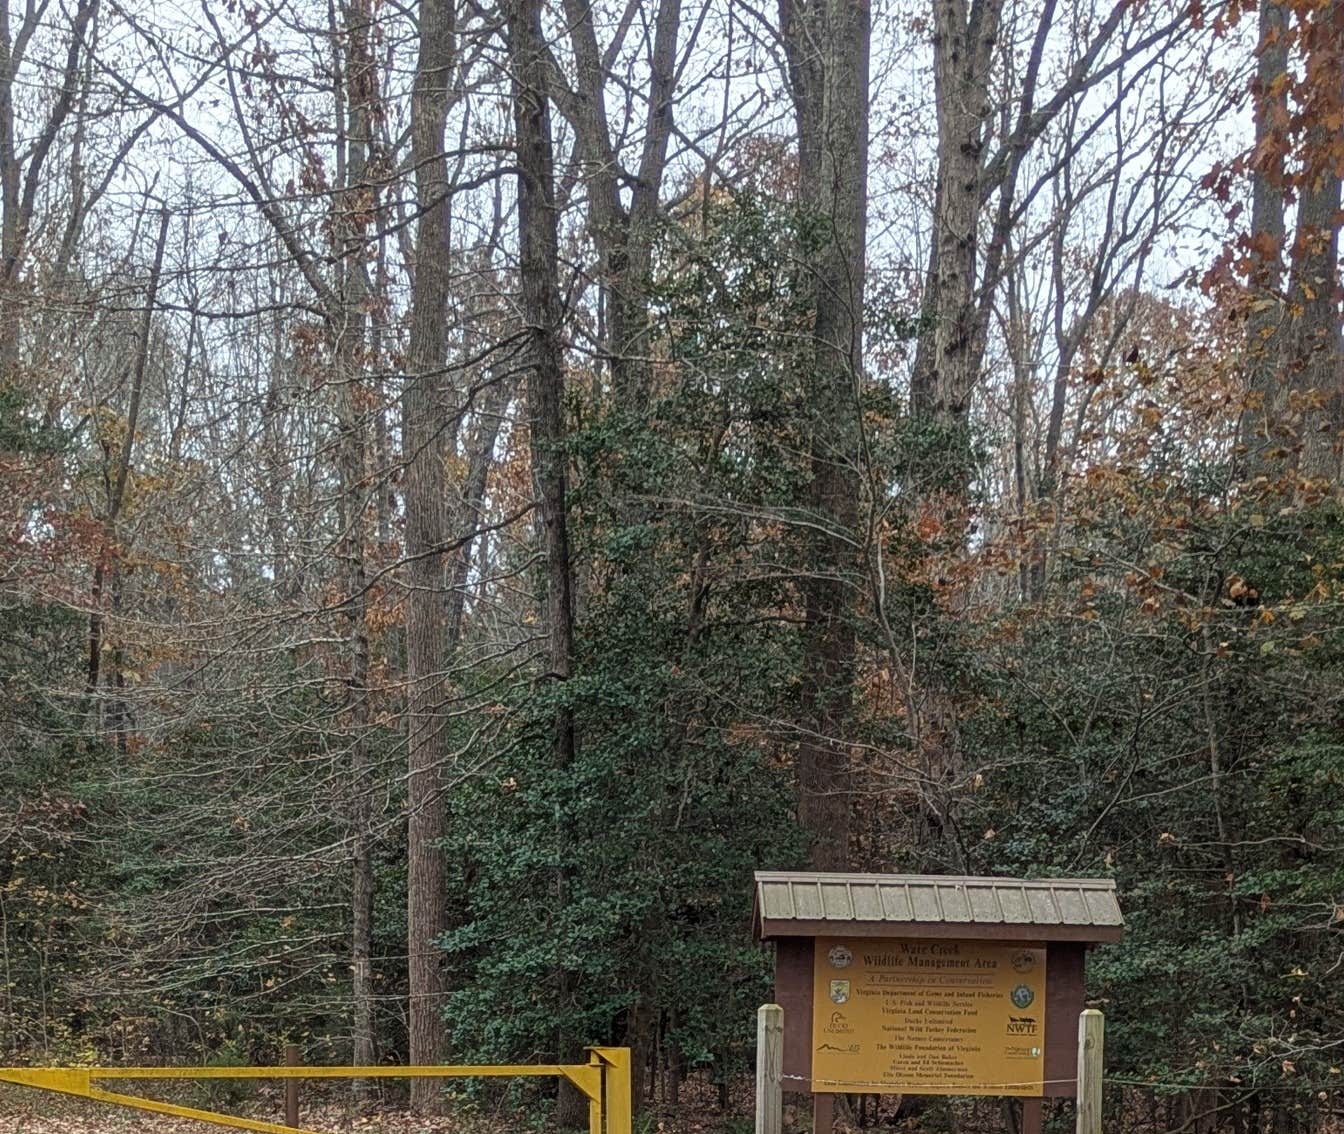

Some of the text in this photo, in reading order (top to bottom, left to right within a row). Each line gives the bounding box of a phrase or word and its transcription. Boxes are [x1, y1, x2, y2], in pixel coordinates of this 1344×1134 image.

[930, 943, 960, 956] Creek
[863, 954, 997, 969] Wildlife Management Area
[878, 975, 925, 985] Partnership
[939, 976, 992, 985] Conservation
[856, 988, 881, 997] Virginia
[882, 989, 916, 998] Department
[952, 1000, 973, 1008] Service
[882, 1007, 906, 1016] Virginia
[882, 1024, 907, 1032] National
[1007, 1023, 1038, 1033] NWTF
[876, 1043, 887, 1051] The
[888, 1043, 912, 1051] Wildlife
[914, 1044, 946, 1052] Foundation
[956, 1045, 981, 1053] Virginia
